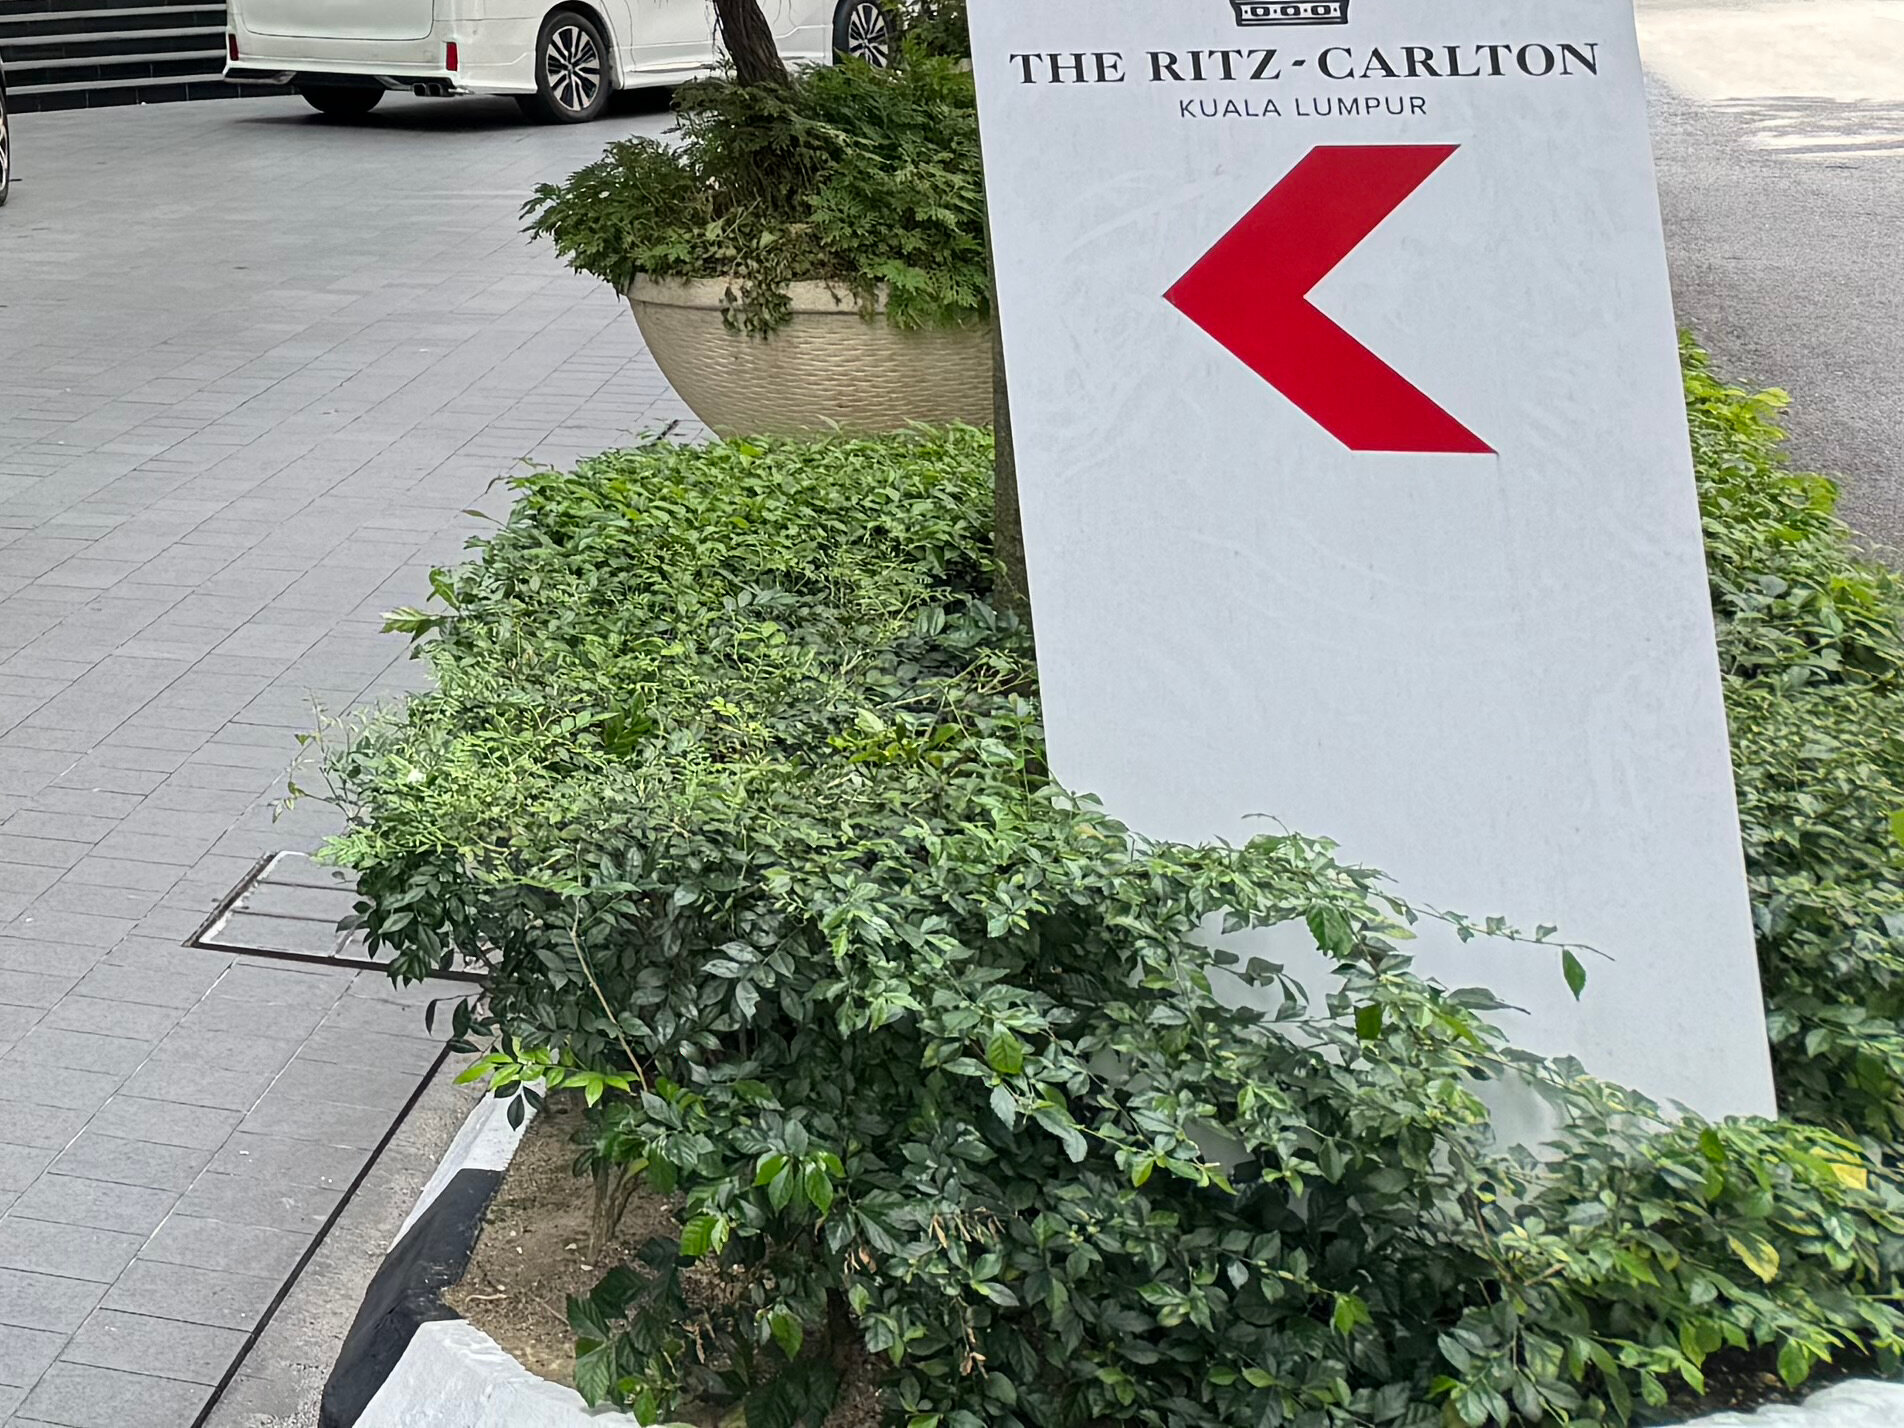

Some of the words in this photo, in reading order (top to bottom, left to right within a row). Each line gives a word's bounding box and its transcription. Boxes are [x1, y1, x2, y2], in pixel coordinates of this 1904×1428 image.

[1009, 52, 1126, 85] THE
[1179, 98, 1282, 118] KUALA
[1295, 96, 1428, 117] LUMPUR
